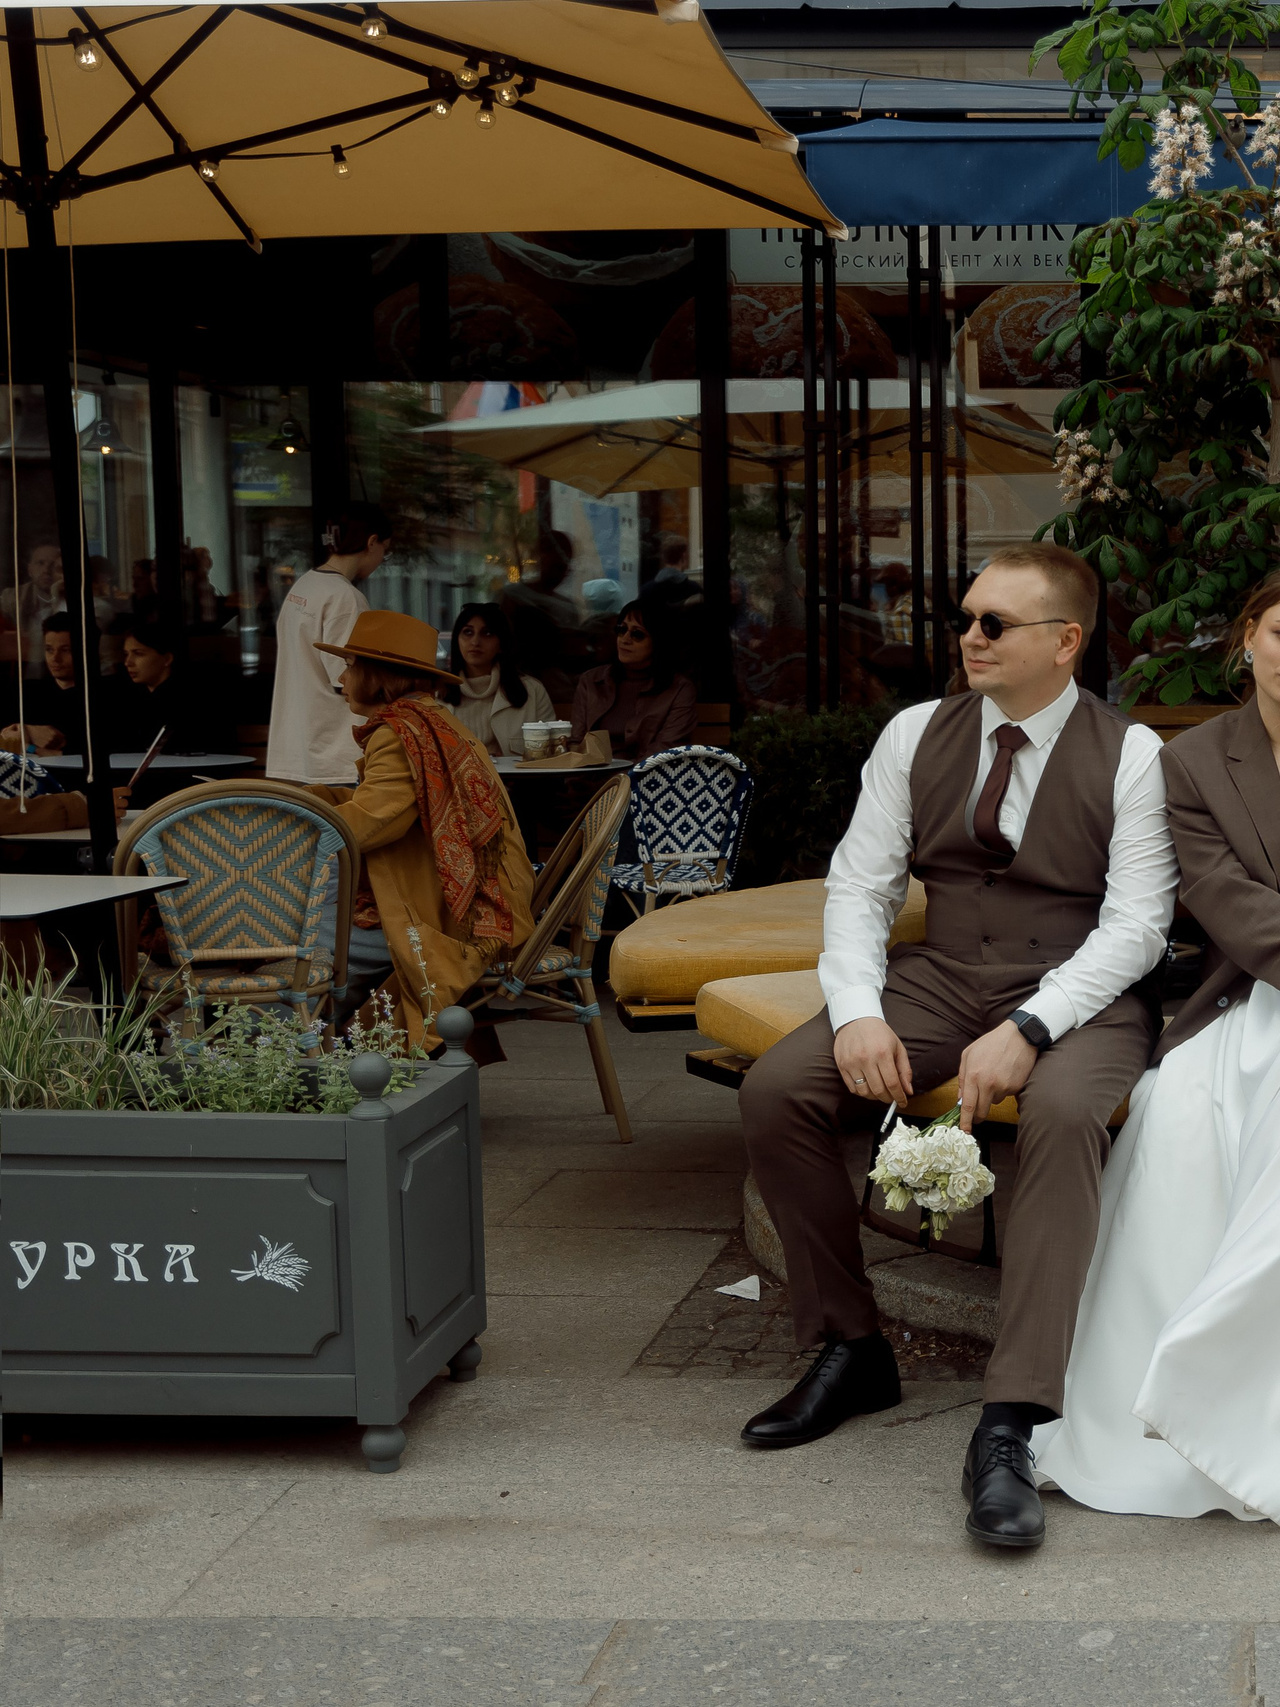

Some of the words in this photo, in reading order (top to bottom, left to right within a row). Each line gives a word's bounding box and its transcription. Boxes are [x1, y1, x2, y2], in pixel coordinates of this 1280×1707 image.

[784, 252, 905, 268] СРСКИЙ
[917, 254, 982, 270] ЦЕПТ
[9, 1241, 199, 1289] УРКА
